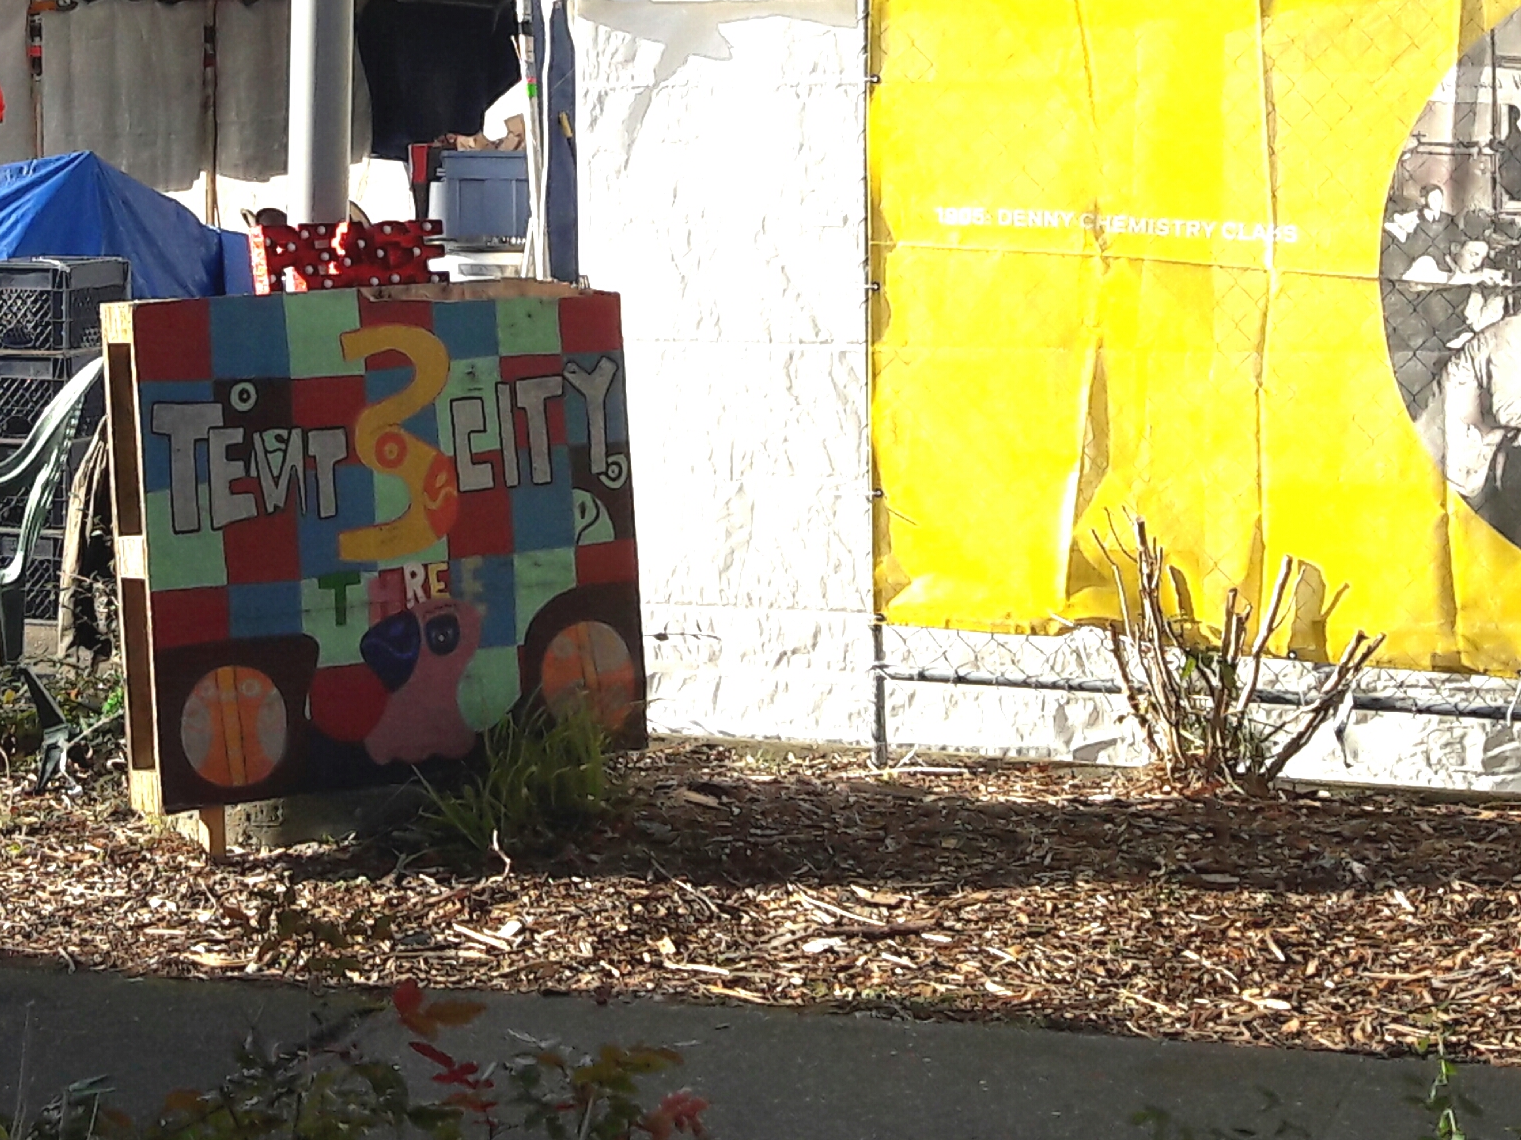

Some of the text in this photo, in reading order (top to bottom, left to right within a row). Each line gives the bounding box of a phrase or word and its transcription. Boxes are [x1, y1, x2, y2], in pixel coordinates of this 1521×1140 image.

[997, 208, 1075, 229] DENNY
[1079, 212, 1217, 239] CHEMISTRY
[151, 324, 617, 560] TENT 3 CITY
